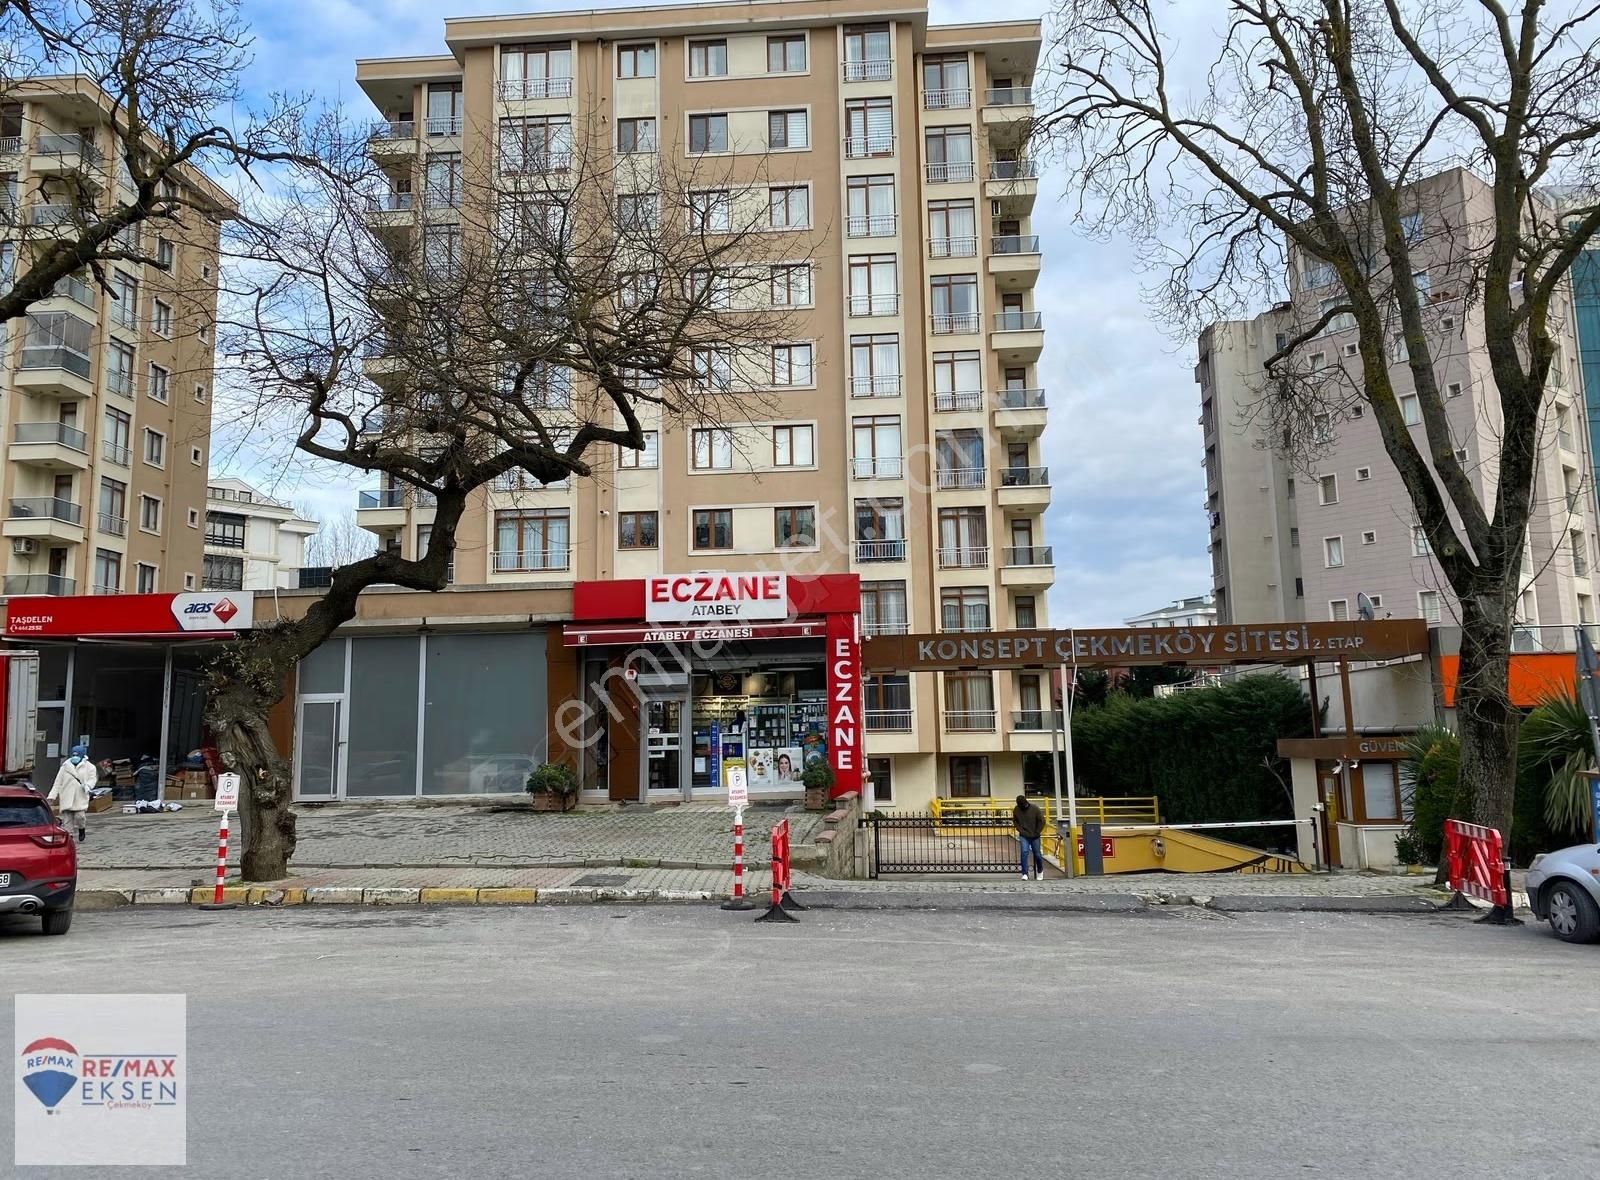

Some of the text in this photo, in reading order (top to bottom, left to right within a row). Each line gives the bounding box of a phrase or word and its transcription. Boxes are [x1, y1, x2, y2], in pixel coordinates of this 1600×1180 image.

[651, 575, 781, 603] ECZANE
[184, 602, 212, 613] aras
[691, 604, 742, 616] ATABEY
[11, 616, 53, 624] TAŞDELEN
[643, 631, 688, 641] ATABEY
[918, 626, 1363, 661] KONSEPT ÇEKMEKÖY SİTESİ 2. ETAP
[834, 638, 855, 770] ECZANE
[1360, 740, 1407, 753] GÜVEN
